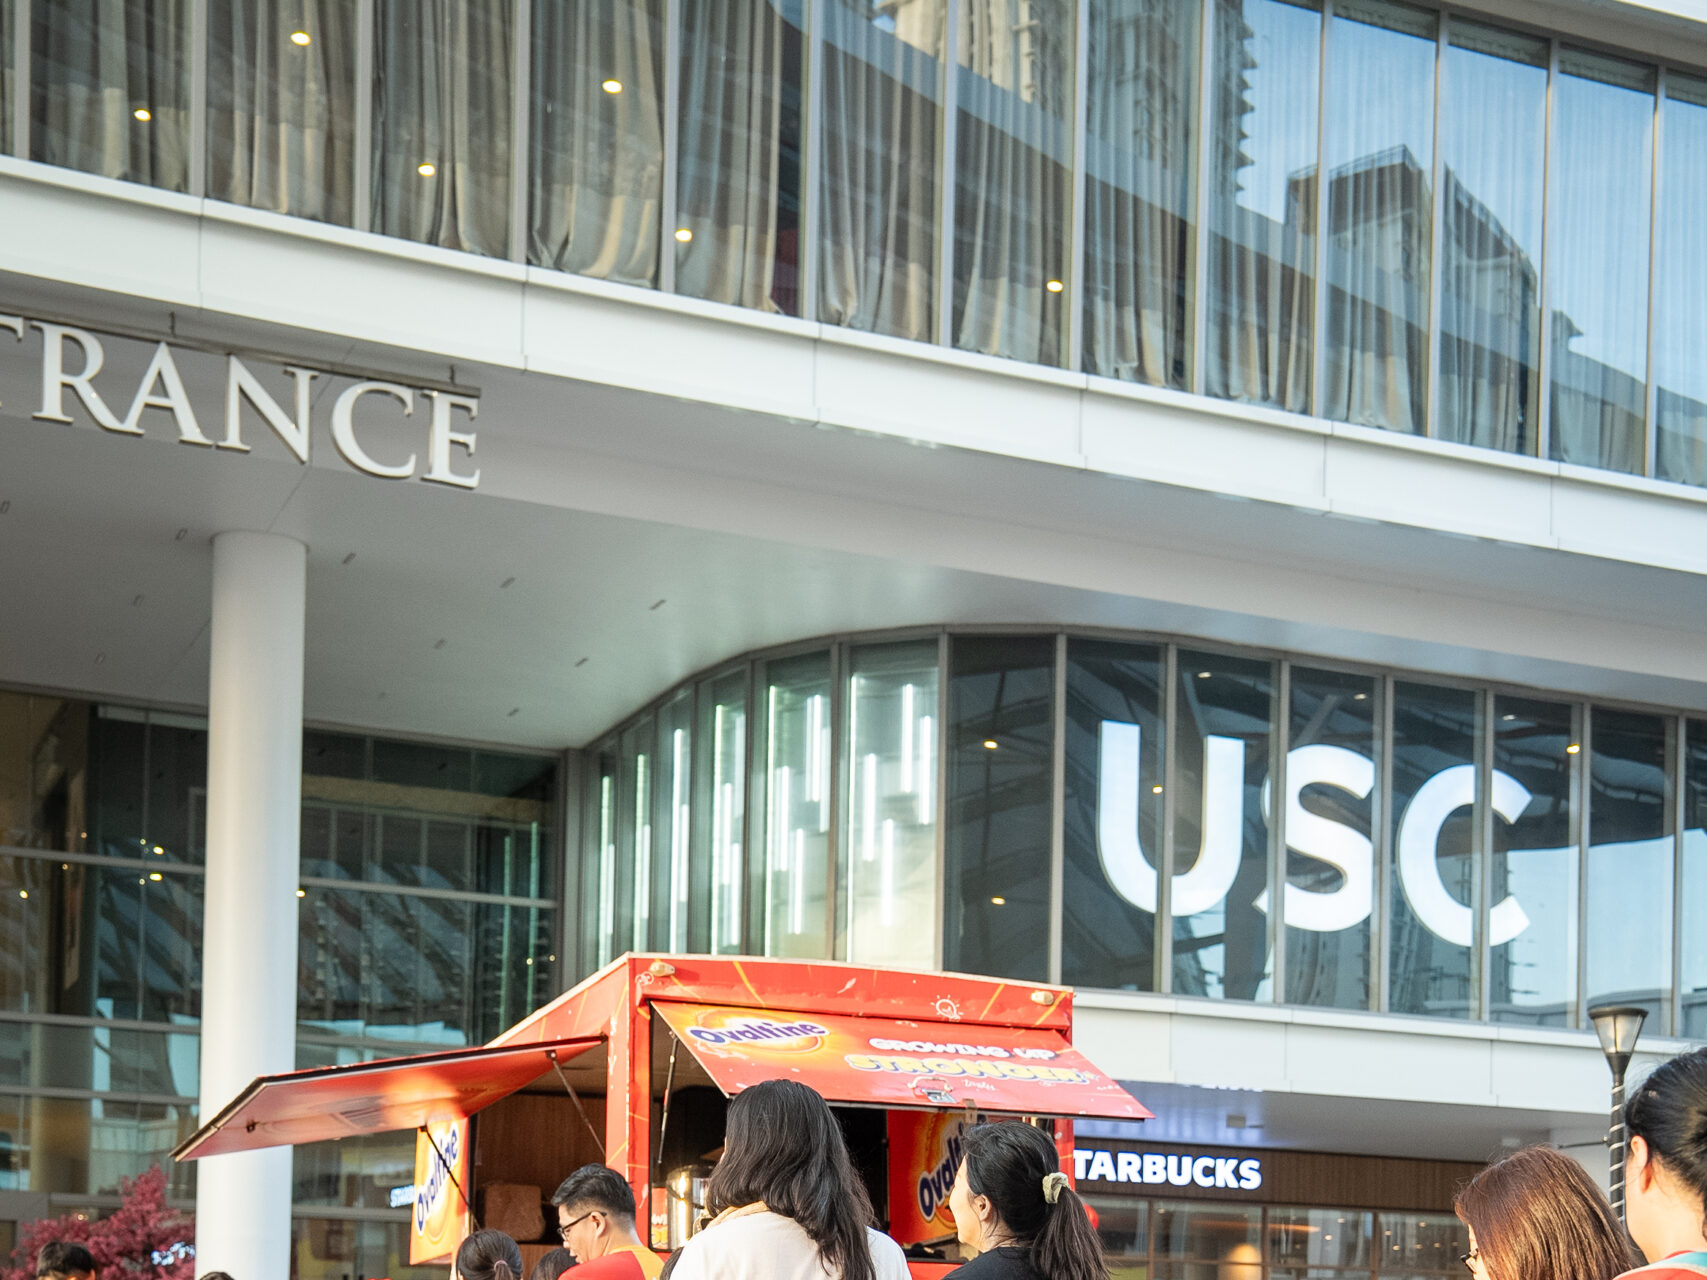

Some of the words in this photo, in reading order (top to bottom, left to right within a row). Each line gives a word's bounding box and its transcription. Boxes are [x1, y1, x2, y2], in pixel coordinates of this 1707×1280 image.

[0, 315, 481, 489] RANCE
[1098, 719, 1533, 947] USC
[688, 1021, 827, 1044] Ovaltine
[869, 1038, 1013, 1058] GROWING
[1013, 1048, 1059, 1060] UP
[1073, 1148, 1262, 1191] TARBUCKS
